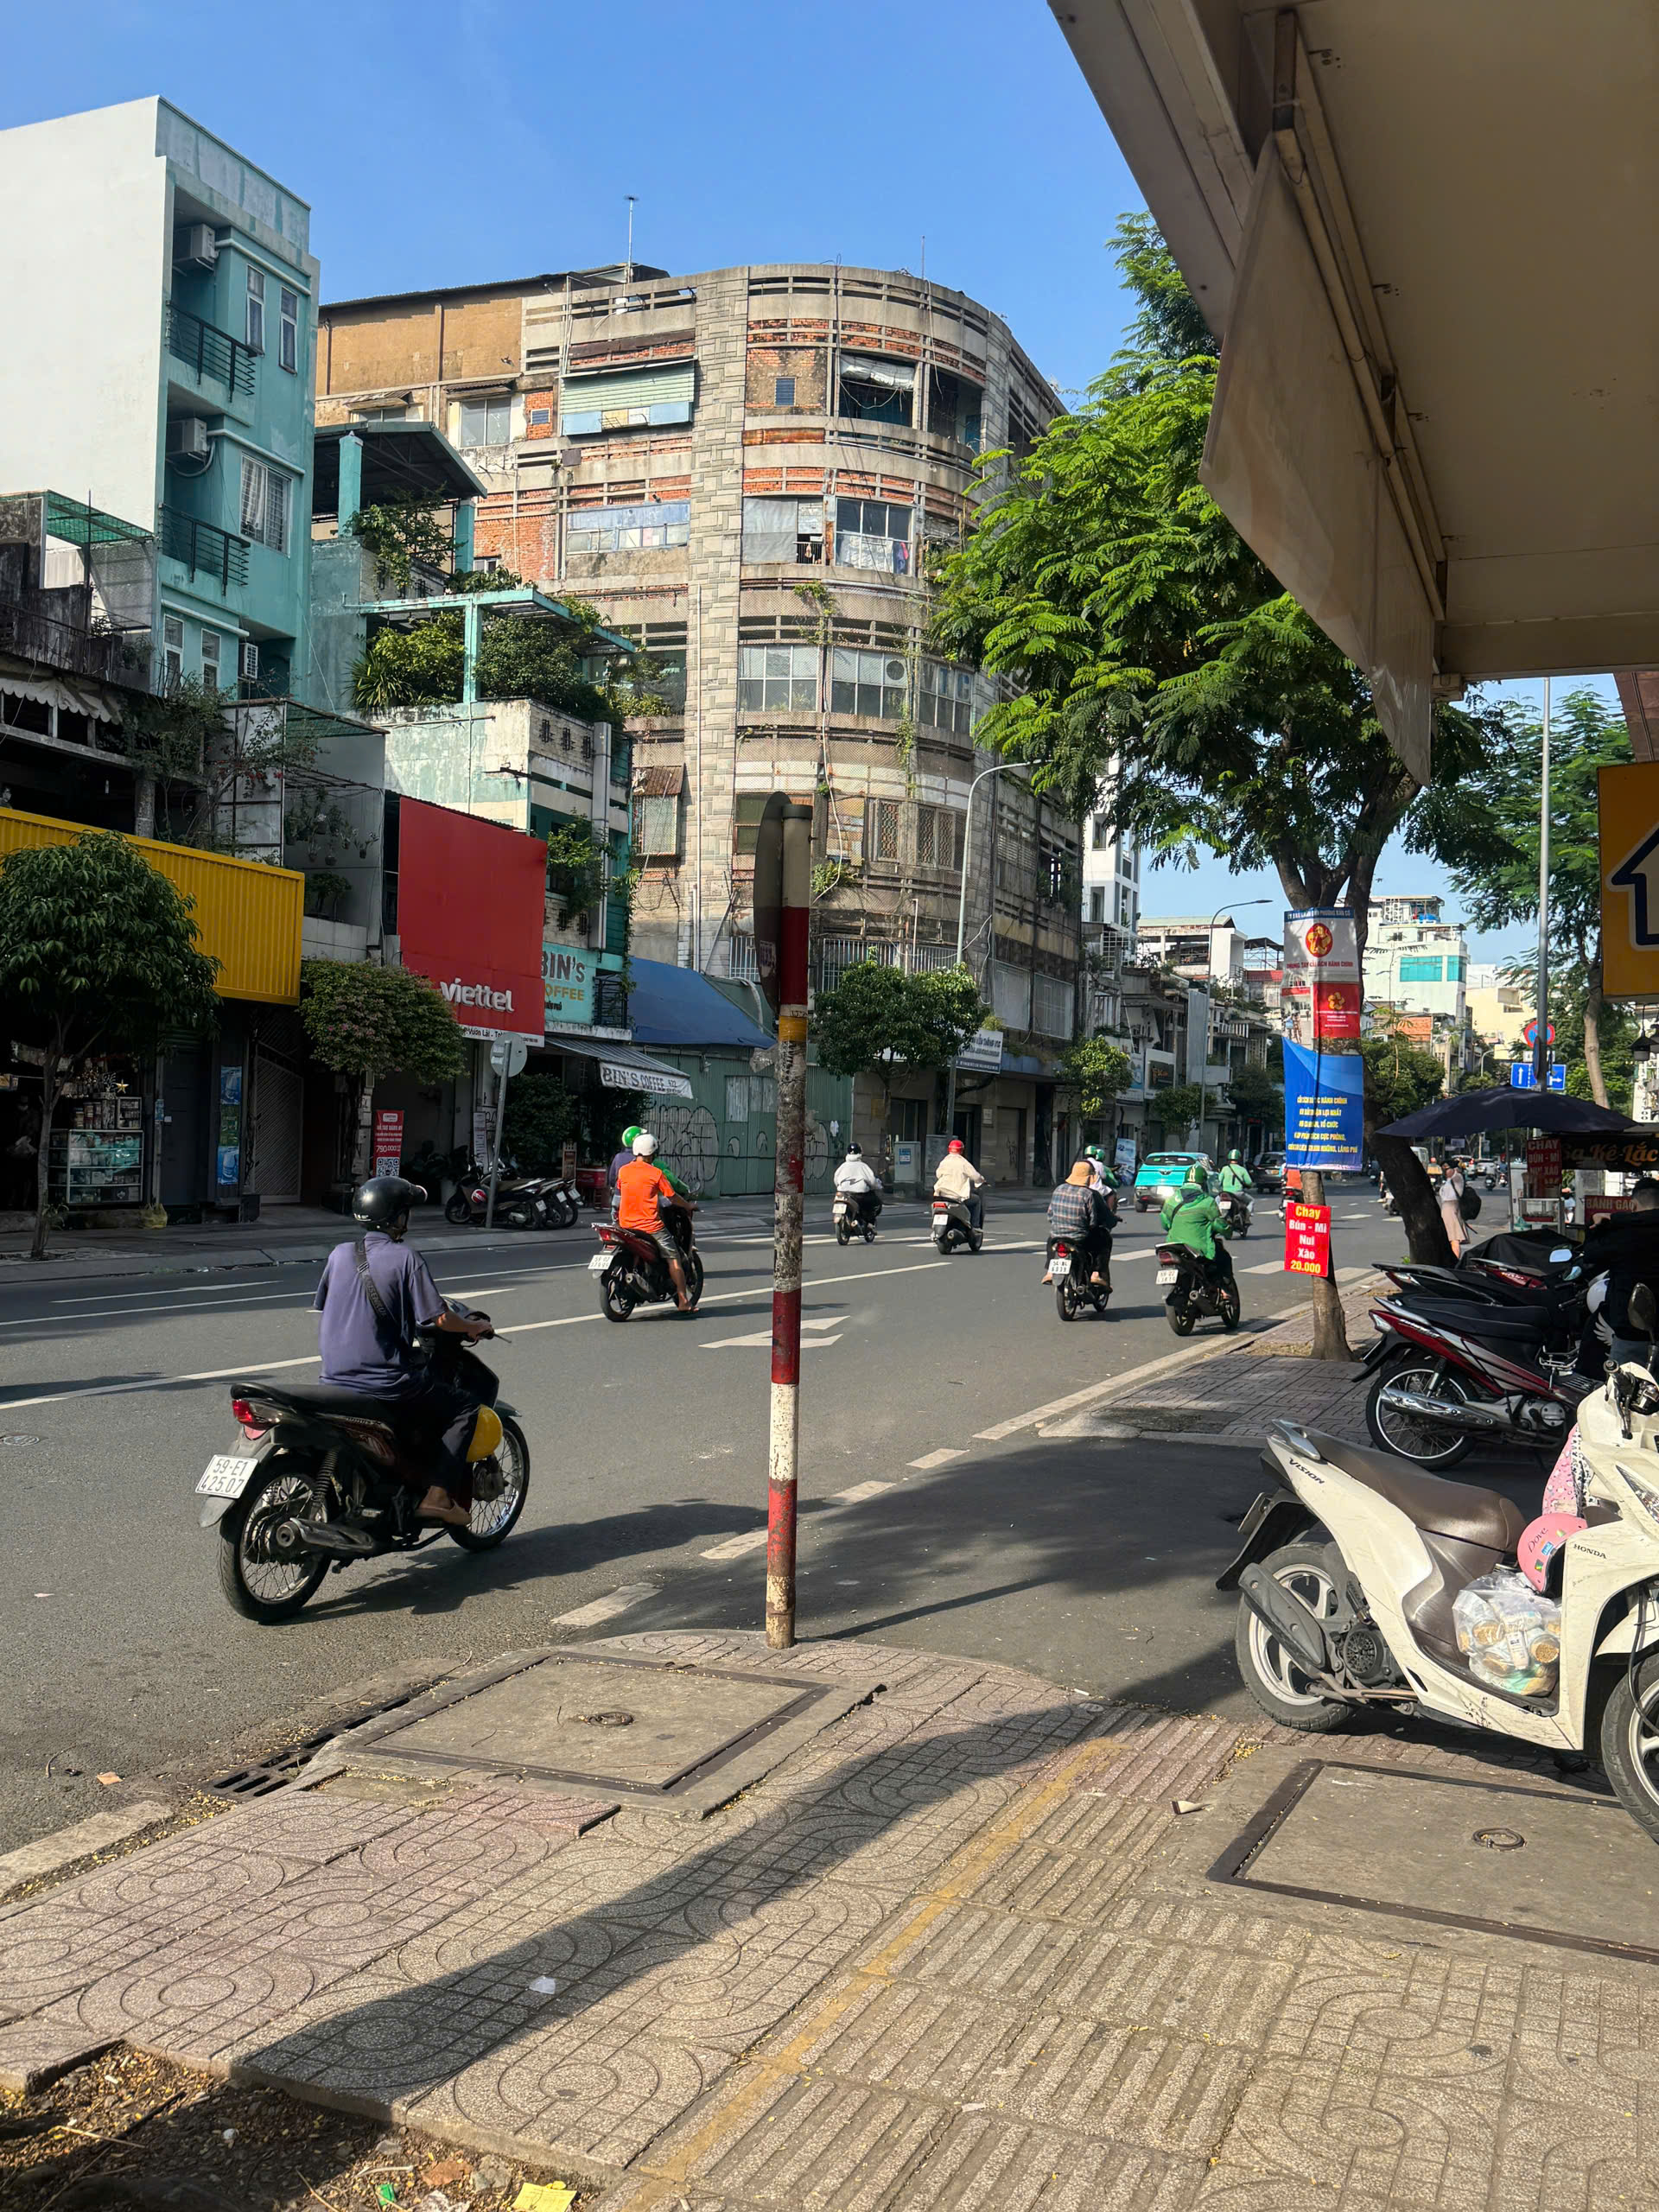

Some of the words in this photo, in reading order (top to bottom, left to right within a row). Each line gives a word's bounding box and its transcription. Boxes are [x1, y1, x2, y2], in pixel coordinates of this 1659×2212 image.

[440, 977, 515, 1013] viettel
[545, 983, 585, 1001] OFFEE
[602, 1066, 639, 1088] BIN'S
[639, 1074, 665, 1091] COFFEE
[1528, 1140, 1560, 1151] CHAY
[1623, 1141, 1659, 1167] Lắc
[1295, 1205, 1321, 1220] Chay
[1288, 1219, 1306, 1231] Bún
[1299, 1234, 1315, 1246] Nui
[1298, 1247, 1315, 1260] Xào
[1290, 1259, 1321, 1274] 20.000
[1288, 1457, 1325, 1484] VISION
[200, 1474, 245, 1494] 425.07
[1573, 1543, 1607, 1560] HONDA
